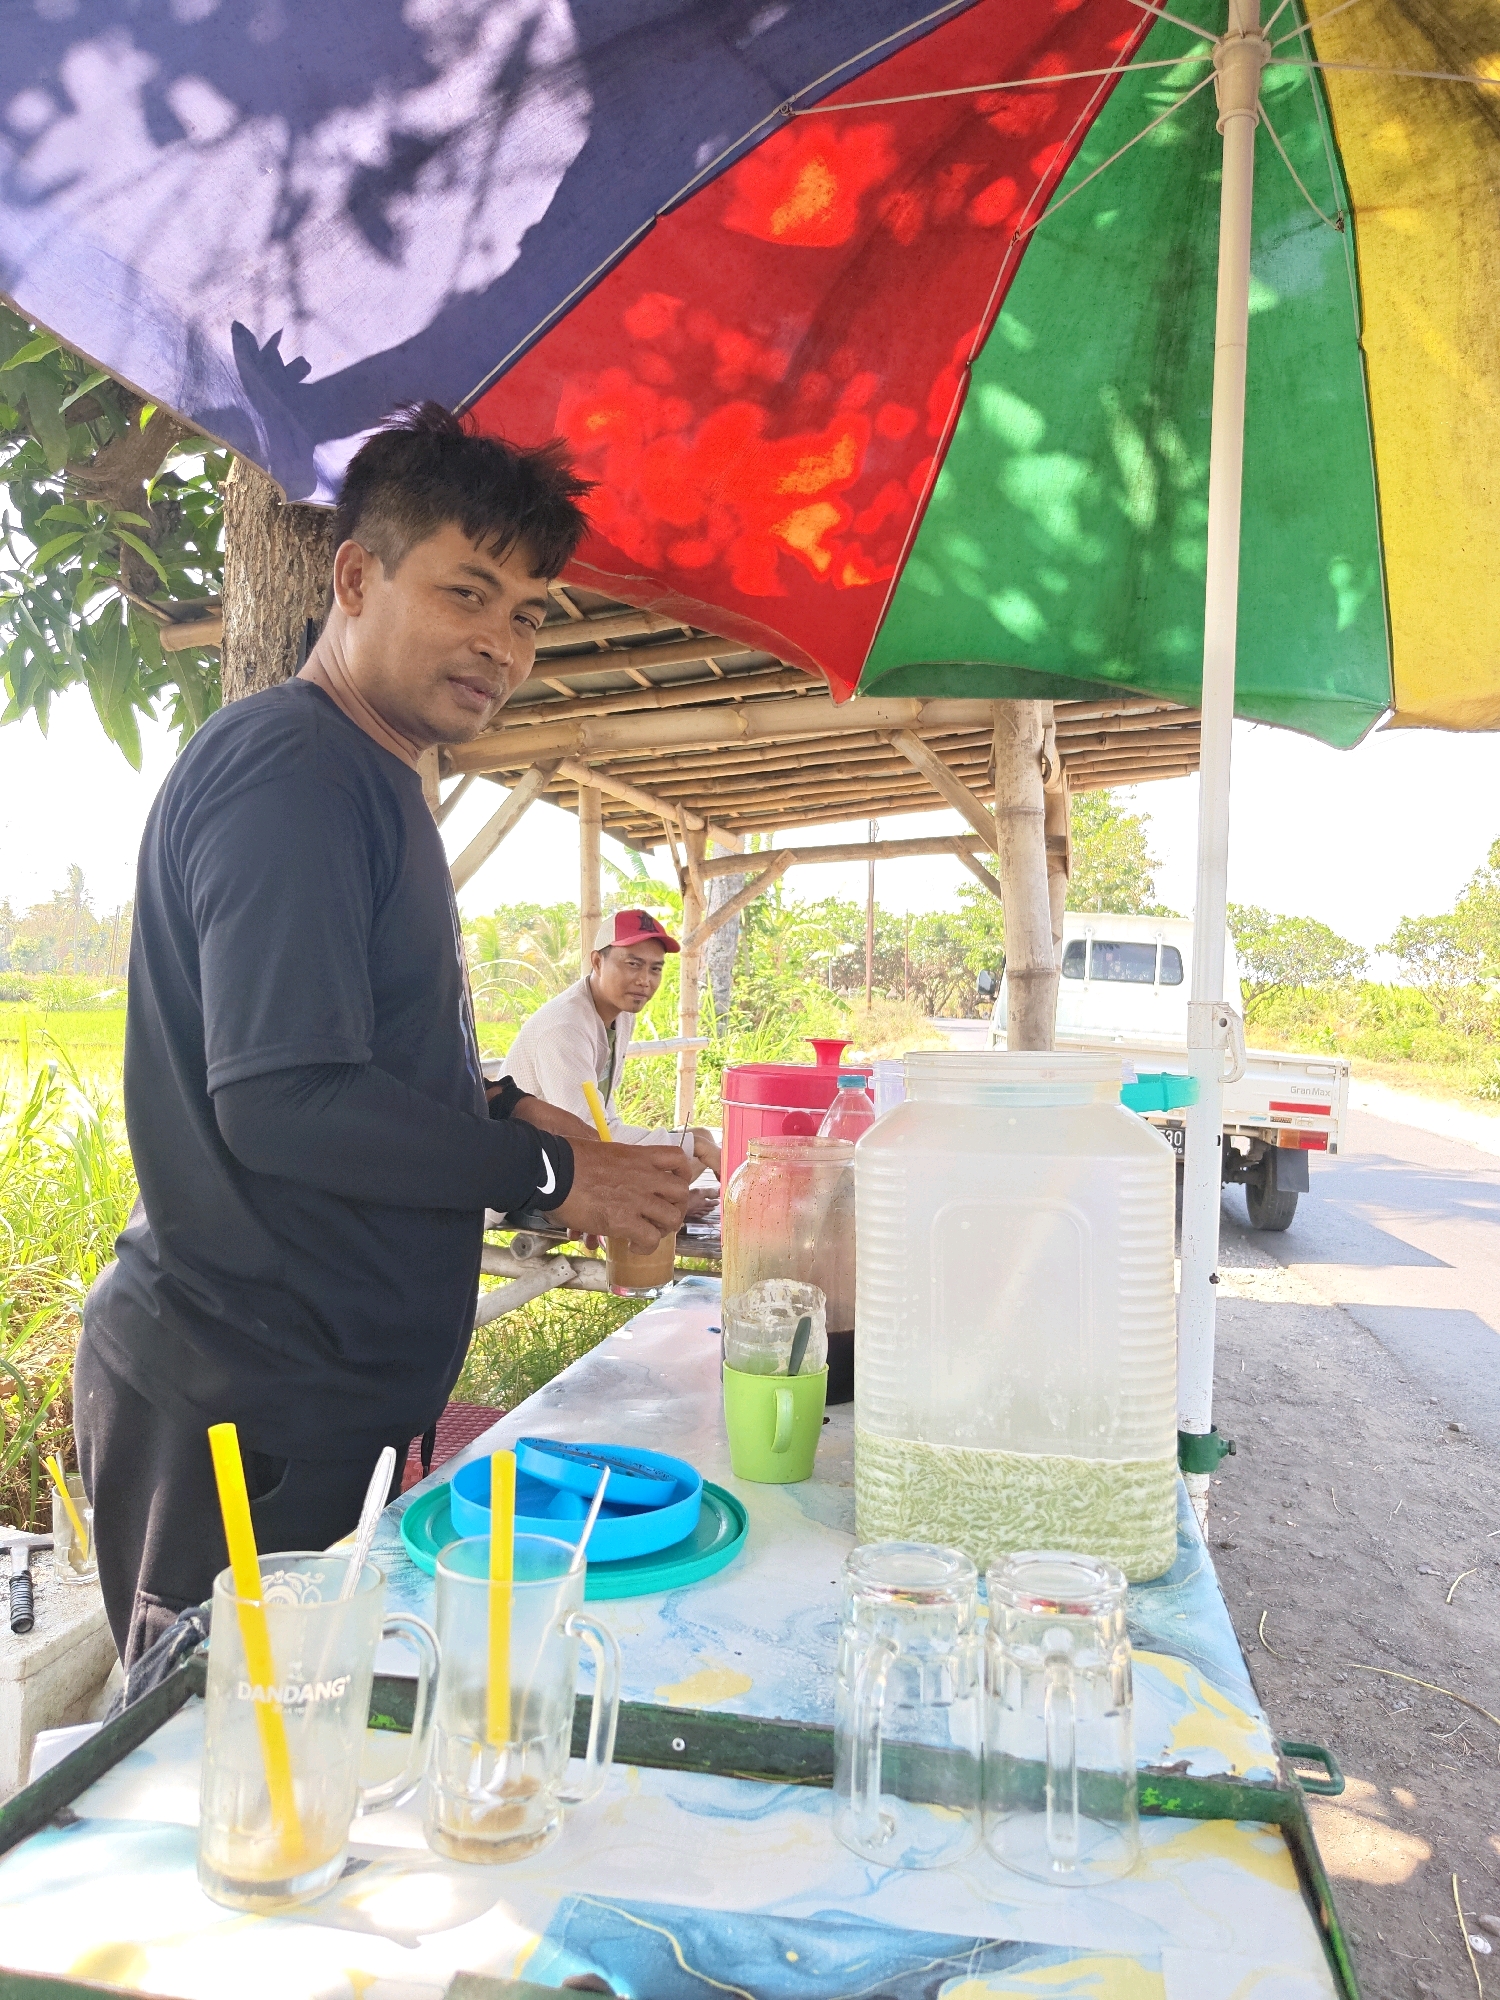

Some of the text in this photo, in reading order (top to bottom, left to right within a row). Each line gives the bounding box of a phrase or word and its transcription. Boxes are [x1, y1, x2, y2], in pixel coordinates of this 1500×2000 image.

[1290, 1085, 1331, 1097] Gran Max
[1158, 1129, 1183, 1147] 30
[237, 1675, 348, 1705] DANDANG
